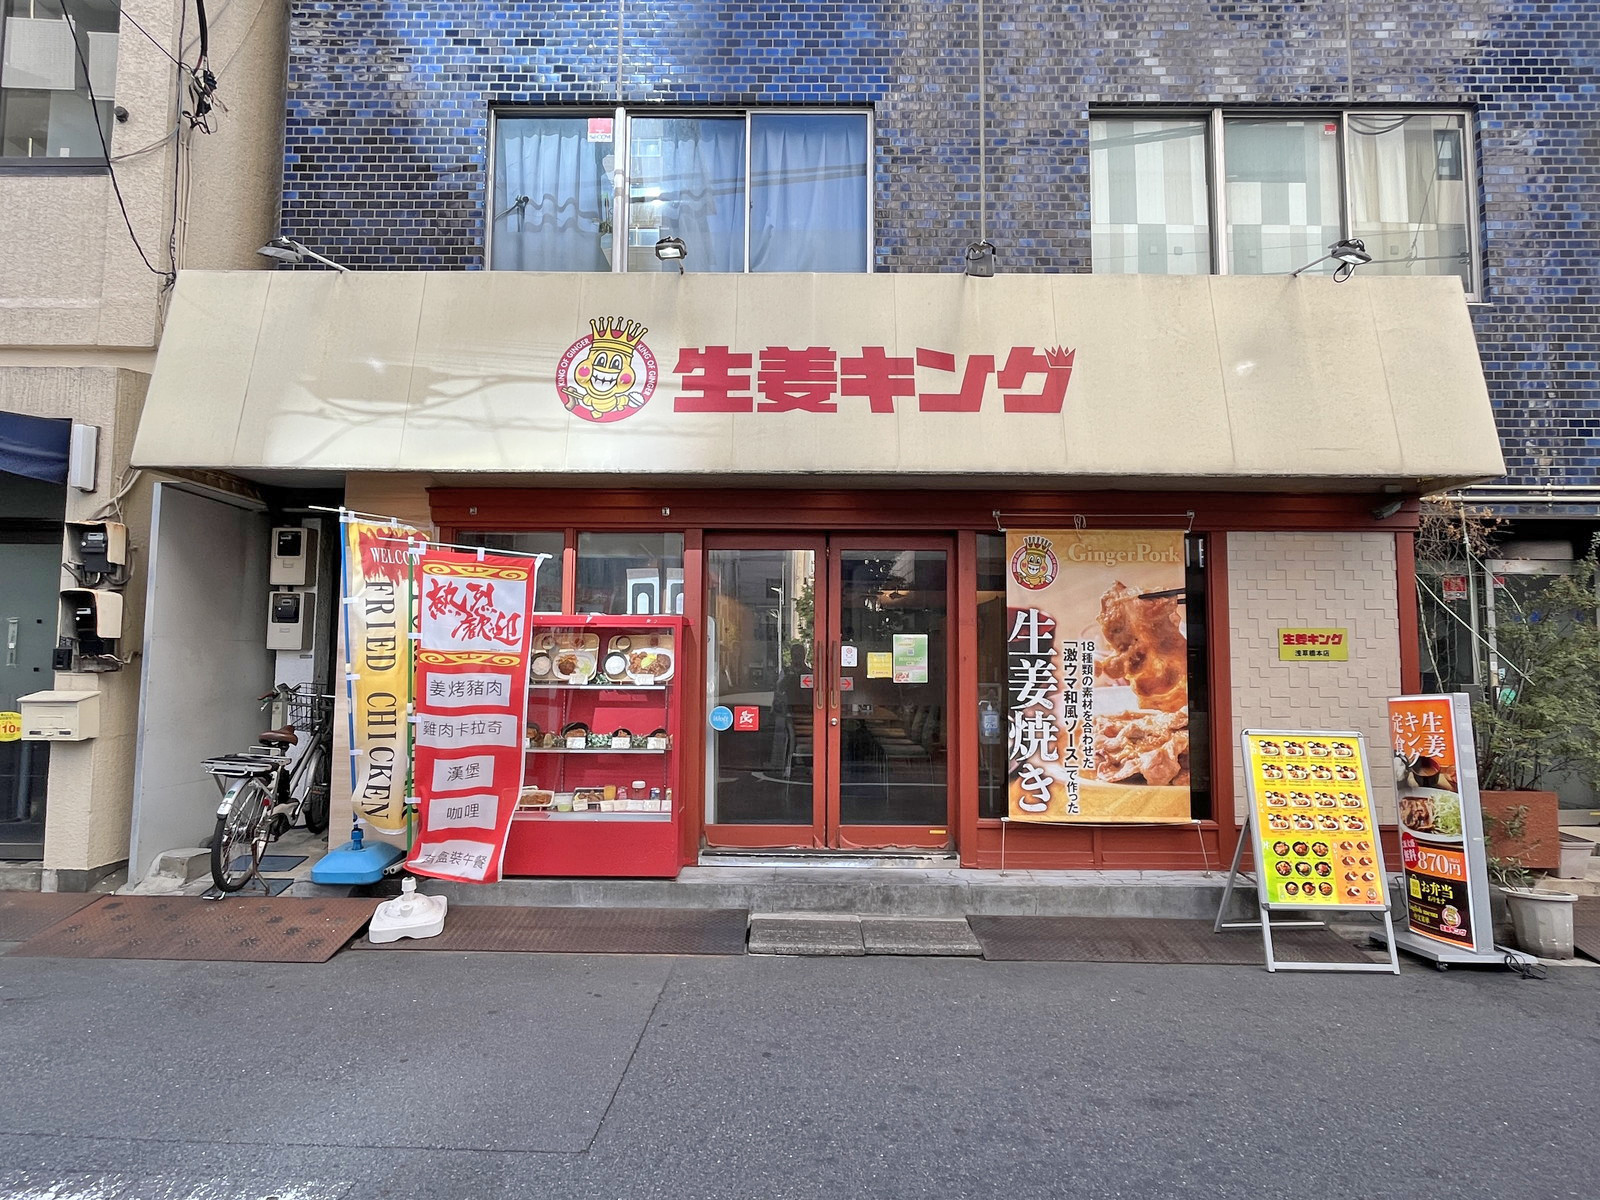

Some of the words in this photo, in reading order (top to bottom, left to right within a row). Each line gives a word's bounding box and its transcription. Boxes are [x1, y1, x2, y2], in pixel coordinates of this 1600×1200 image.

[566, 337, 590, 359] GINGER
[637, 343, 652, 360] KING
[560, 357, 569, 367] OF
[646, 360, 656, 369] OF
[558, 367, 566, 387] KING
[643, 370, 657, 396] GINGER
[672, 344, 1076, 413] 生姜キング
[1067, 542, 1182, 568] GingerPork
[365, 581, 397, 671] FRIED
[1282, 633, 1343, 645] 生姜キング
[429, 679, 503, 698] 姜烤豬肉
[1007, 607, 1060, 813] 生姜焼き
[1080, 641, 1095, 770] 18種類の素材を合わせた
[422, 720, 503, 738] 雞肉卡拉奇
[1063, 640, 1080, 814] 「激ウマ和風ソース」で作った
[1391, 711, 1407, 757] 定食
[1404, 711, 1424, 768] キング
[1421, 711, 1446, 758] 生姜
[360, 692, 397, 820] CHICKEN
[446, 762, 481, 782] 漢堡
[446, 803, 480, 820] 咖哩
[1417, 850, 1461, 876] 870円
[1421, 881, 1454, 899] お弁当
